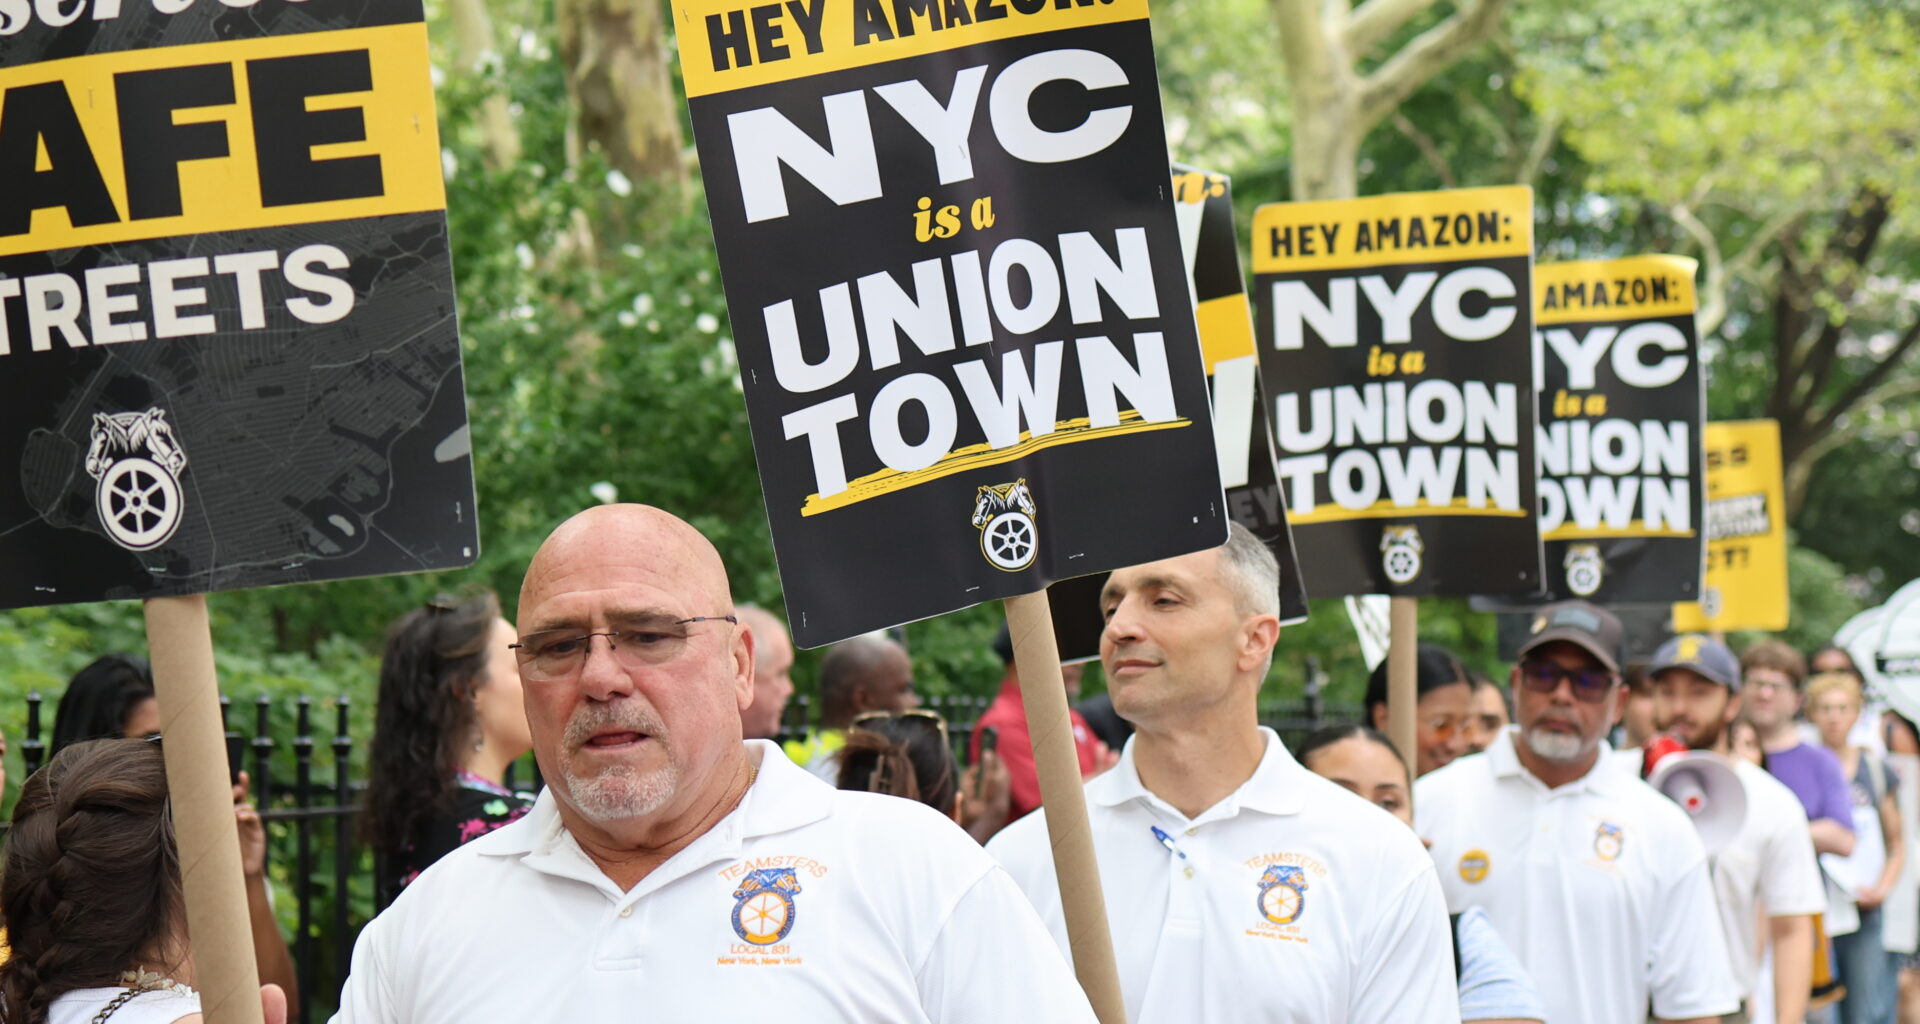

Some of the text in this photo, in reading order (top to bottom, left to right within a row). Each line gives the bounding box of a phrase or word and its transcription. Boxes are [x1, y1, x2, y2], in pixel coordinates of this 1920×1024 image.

[705, 0, 825, 72] HEY
[0, 48, 385, 237] AFE
[726, 49, 1133, 223] NYC
[913, 195, 995, 242] is a
[1271, 211, 1513, 258] HEY AMAZON:
[0, 244, 355, 356] REETS
[763, 227, 1160, 393] UNION
[1272, 266, 1517, 350] NYC
[1542, 276, 1680, 312] AMAZON:
[1366, 346, 1426, 377] is a
[781, 332, 1178, 500] TOWN
[1275, 379, 1518, 453] UNION
[1553, 389, 1608, 418] is a
[1537, 418, 1690, 478] NION
[1278, 446, 1520, 514] TOWN
[1539, 476, 1692, 534] OWN
[719, 855, 829, 881] TEAMSTERS
[1243, 852, 1327, 878] TEAMSTERS
[717, 957, 737, 965] New
[761, 957, 781, 965] New
[730, 944, 769, 954] LOCAL
